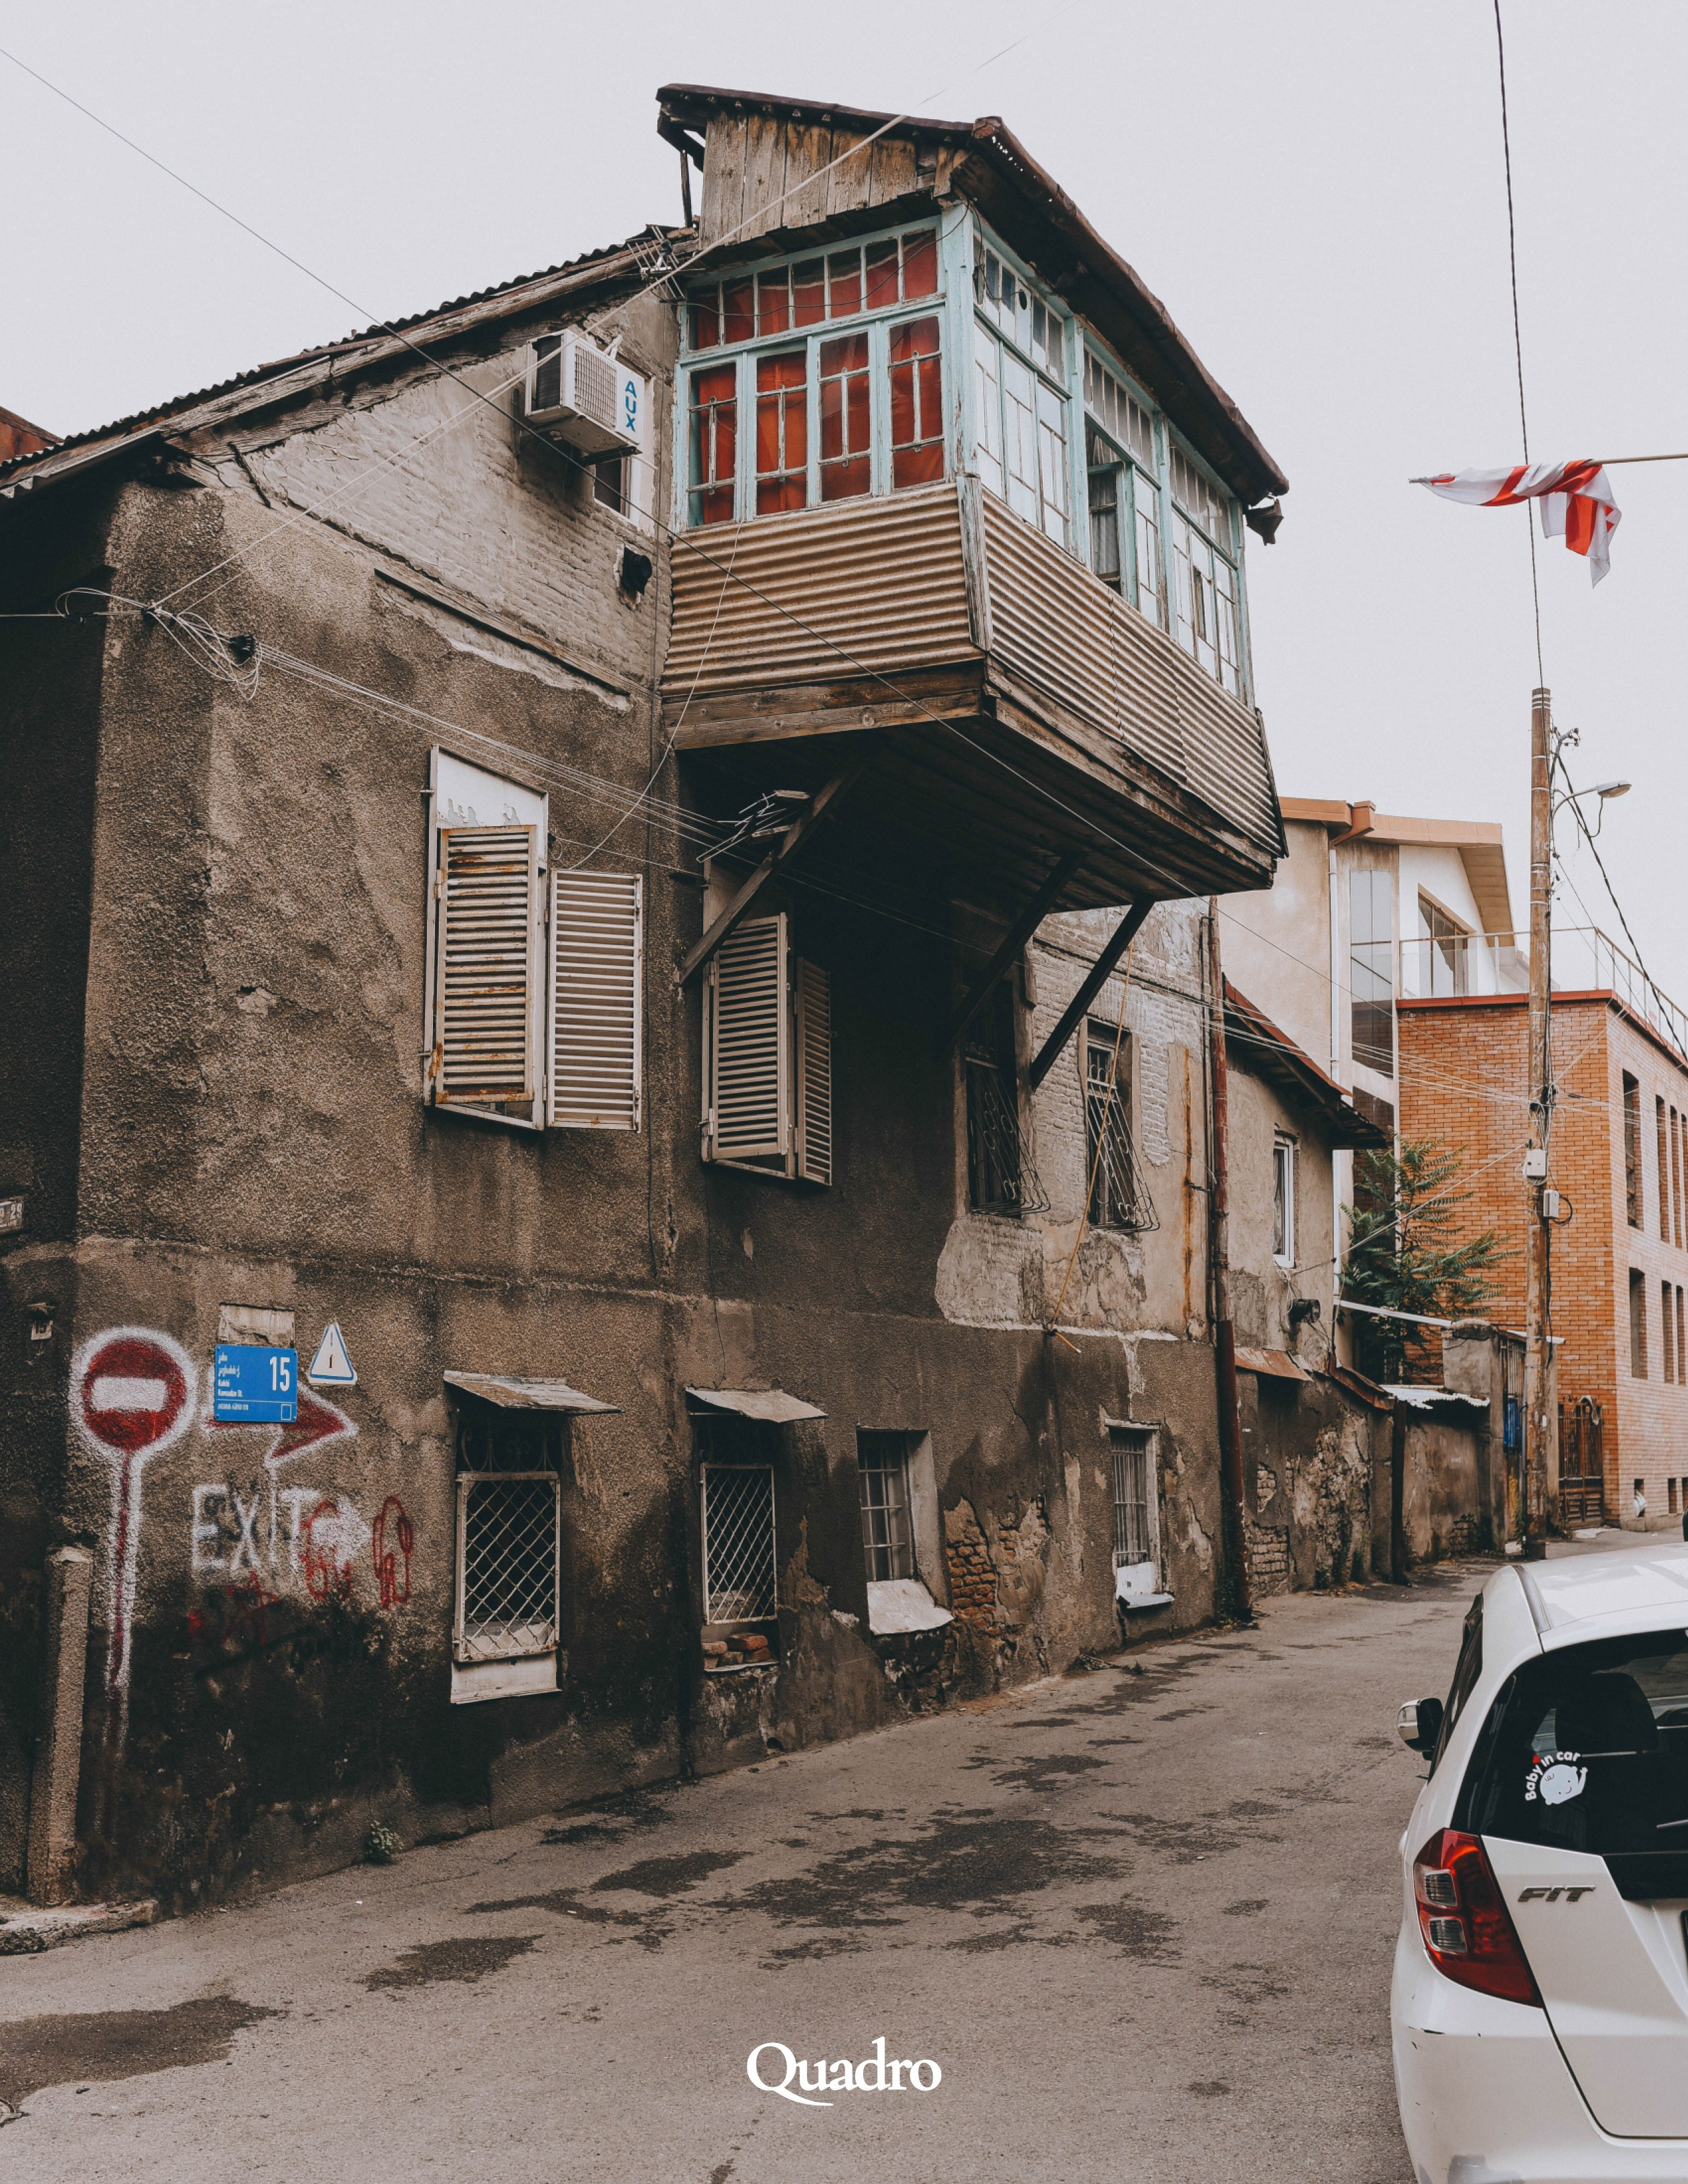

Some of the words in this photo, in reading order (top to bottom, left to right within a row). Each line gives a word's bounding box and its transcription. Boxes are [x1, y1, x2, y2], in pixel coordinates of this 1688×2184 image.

[625, 381, 637, 432] AUX
[269, 1356, 291, 1392] 15
[192, 1483, 320, 1572] EXIT
[1524, 1764, 1544, 1801] Baby
[1540, 1754, 1554, 1766] in
[1556, 1751, 1581, 1762] car
[1517, 1886, 1596, 1902] FIT
